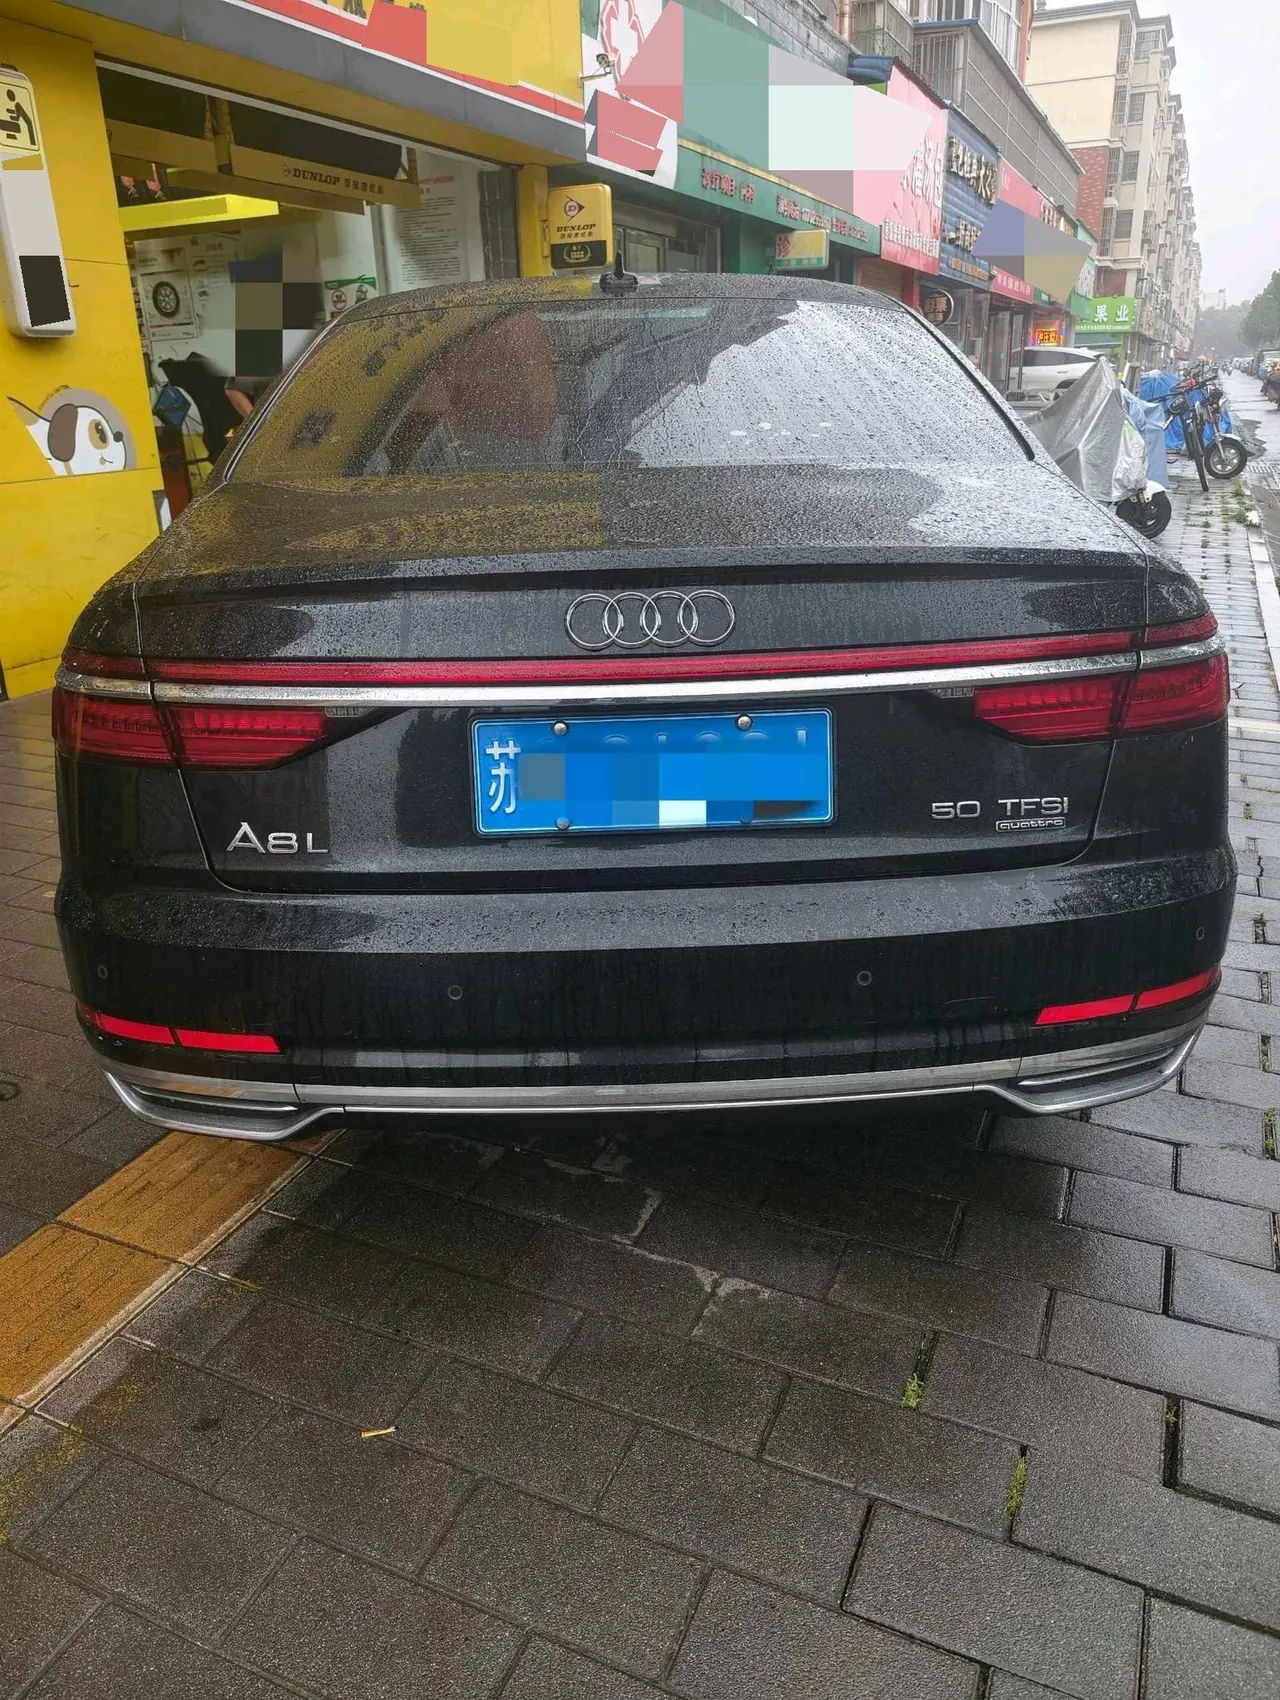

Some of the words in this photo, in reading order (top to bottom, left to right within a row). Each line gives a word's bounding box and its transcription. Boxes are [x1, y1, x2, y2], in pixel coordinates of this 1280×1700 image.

[292, 167, 340, 186] DUNLOP
[556, 223, 597, 233] DUNLOP
[931, 800, 981, 819] 50
[997, 796, 1069, 816] TFSI
[998, 818, 1065, 831] quattro
